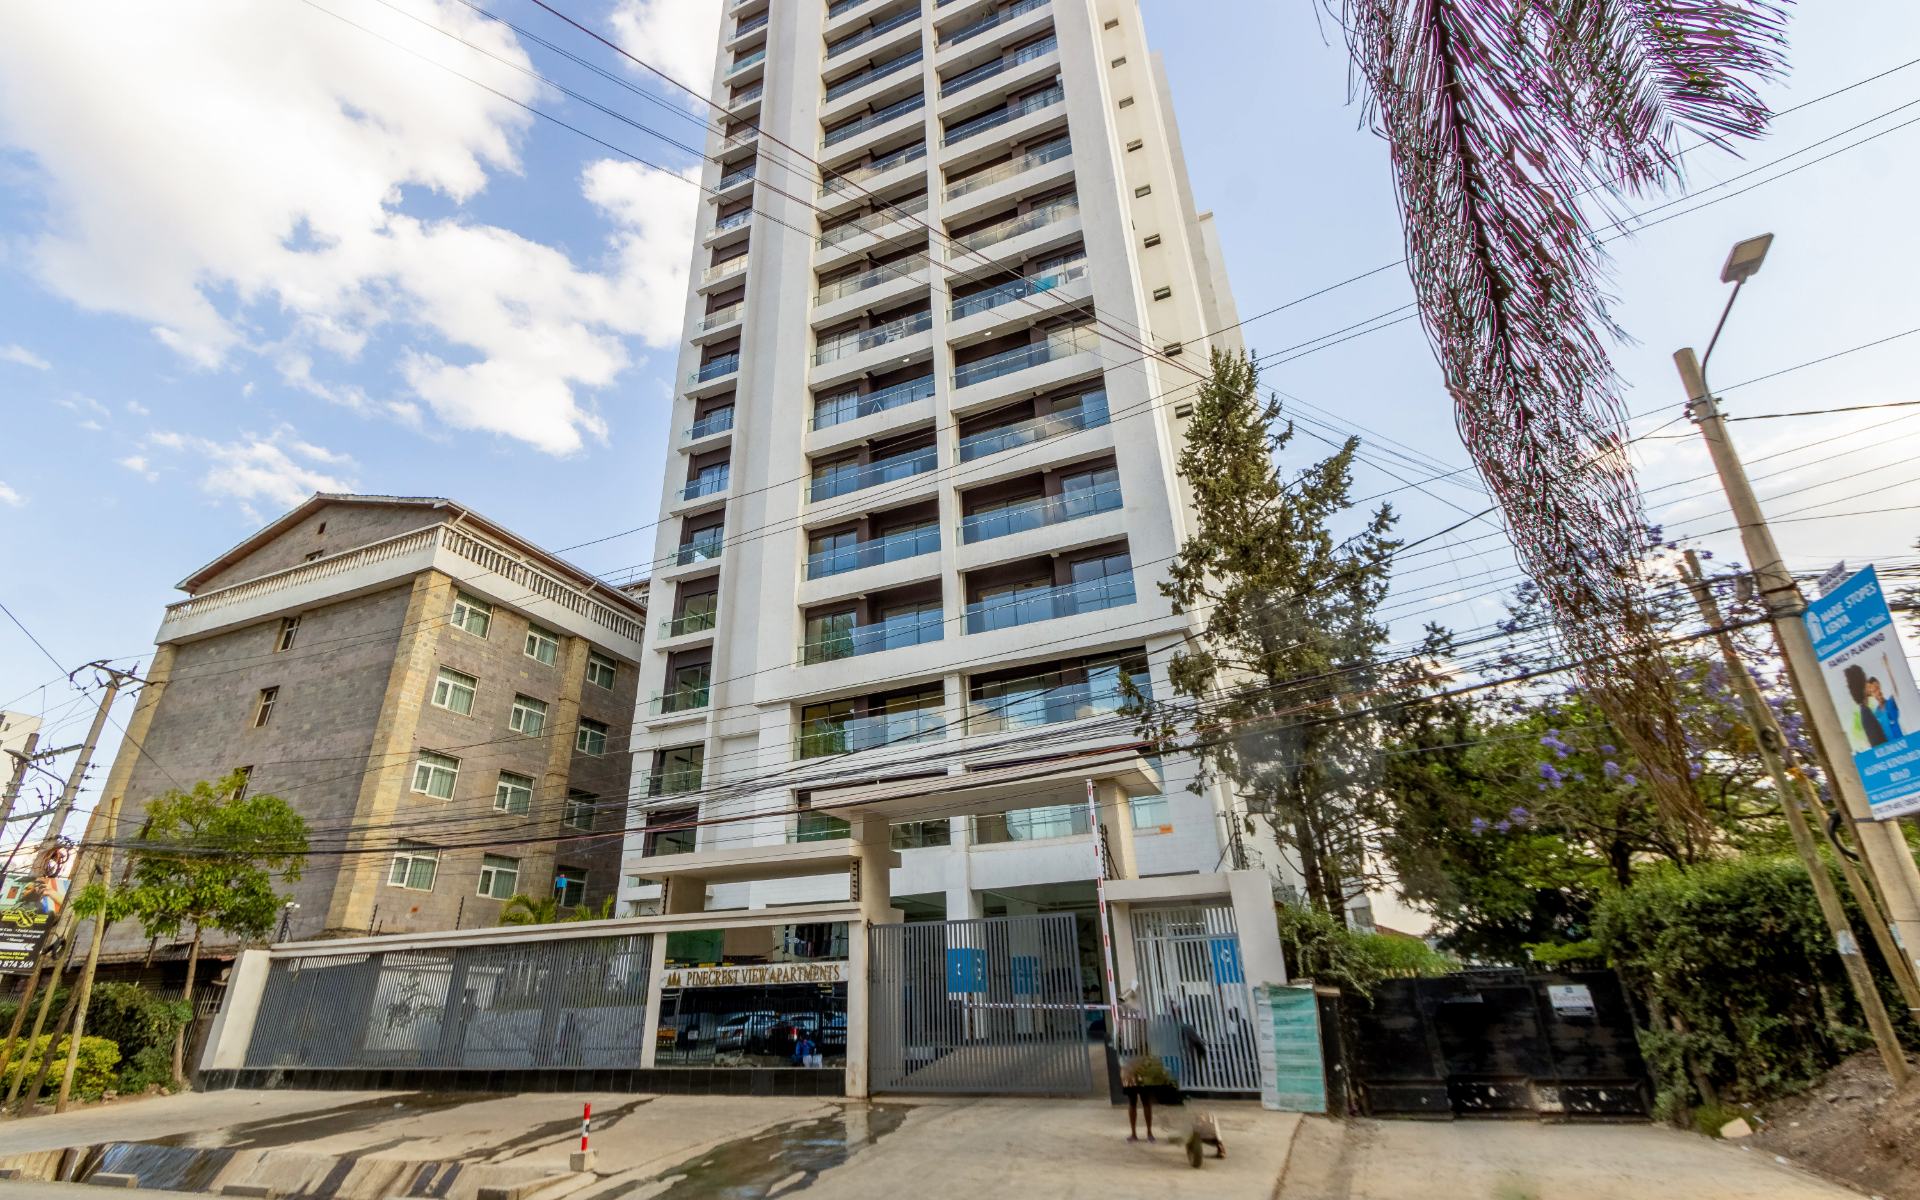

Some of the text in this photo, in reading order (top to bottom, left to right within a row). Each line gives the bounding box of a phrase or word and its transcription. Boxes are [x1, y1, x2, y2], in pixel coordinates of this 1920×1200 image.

[1845, 582, 1877, 608] STOPES
[1828, 652, 1850, 668] FAMILY
[1851, 633, 1886, 655] PLANNING
[2, 960, 18, 968] 874
[18, 960, 34, 968] 269
[686, 965, 840, 986] PINECREST VIEW APARTMENTS
